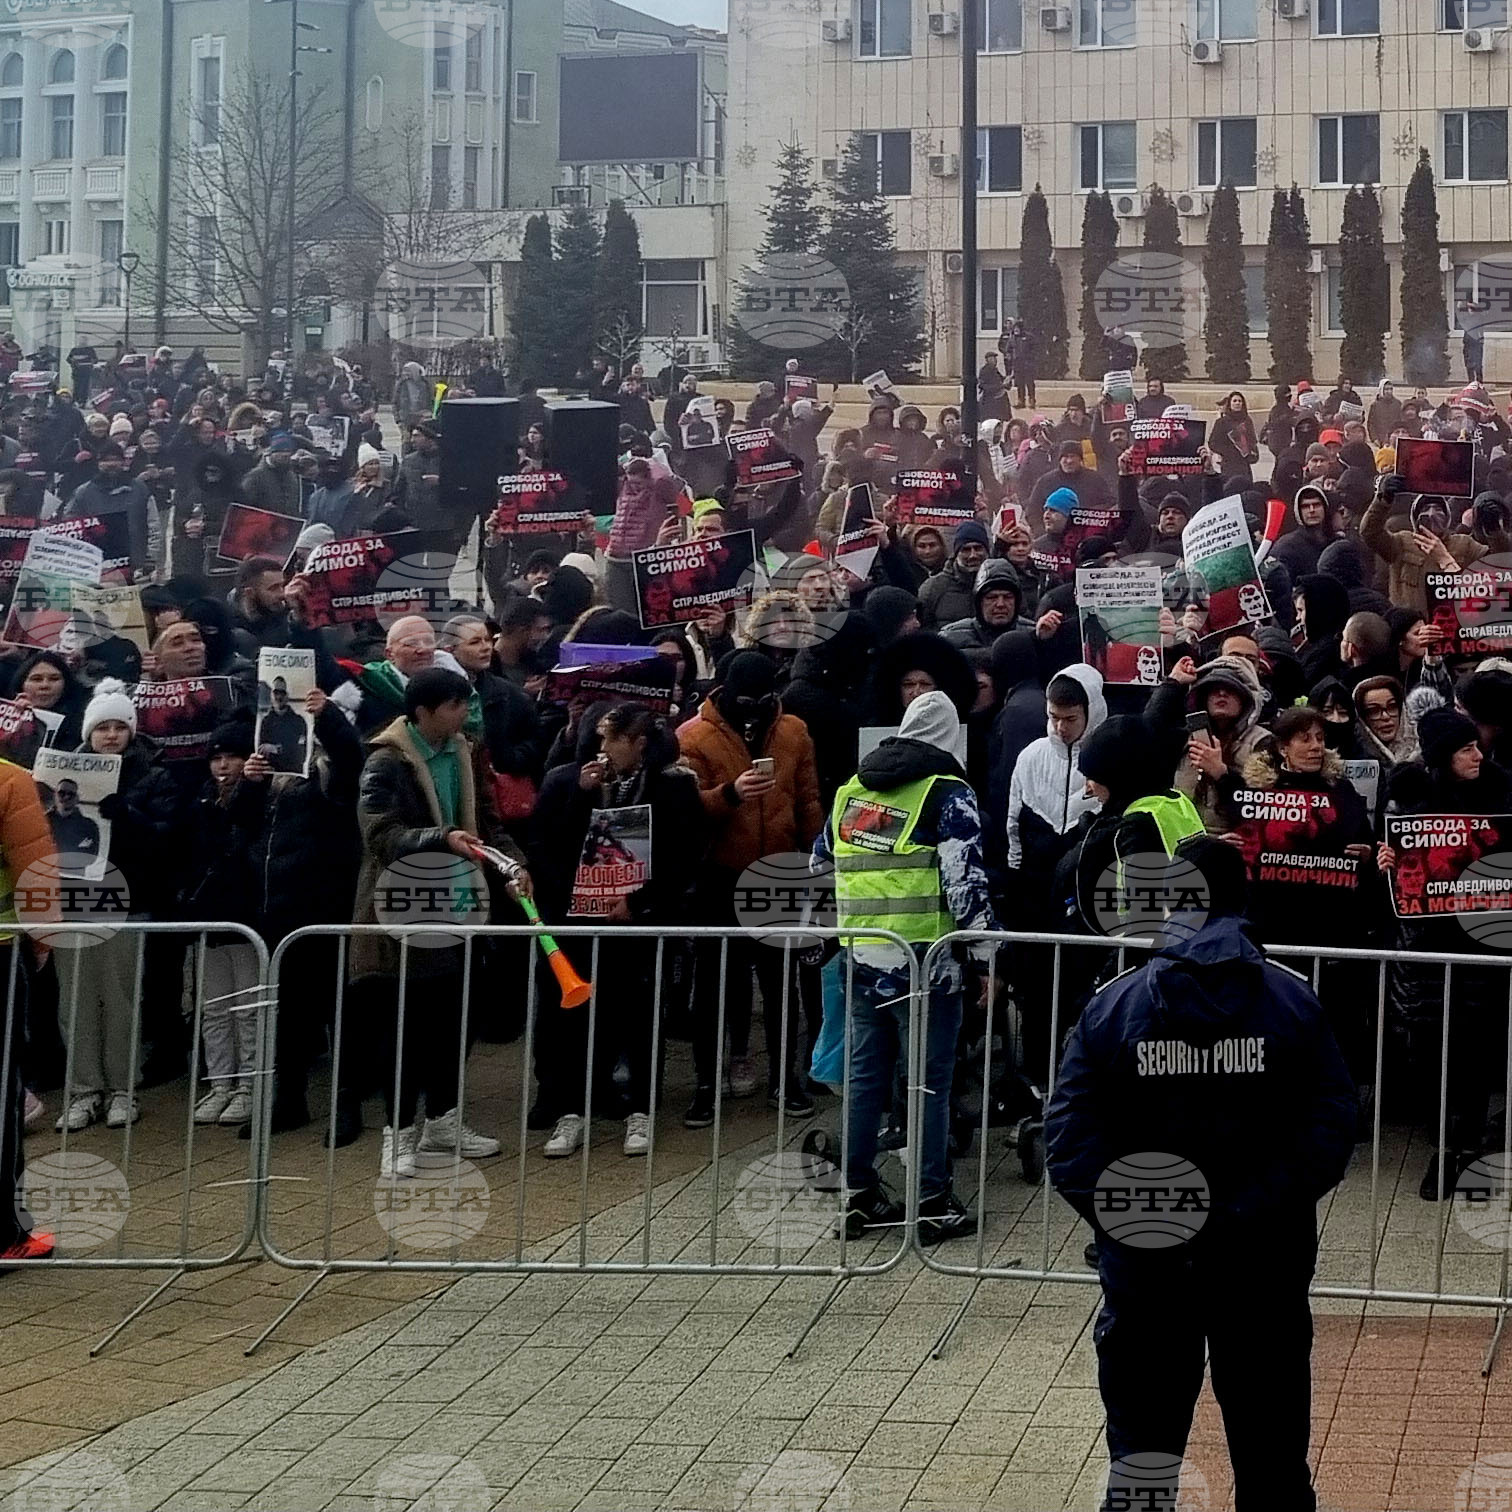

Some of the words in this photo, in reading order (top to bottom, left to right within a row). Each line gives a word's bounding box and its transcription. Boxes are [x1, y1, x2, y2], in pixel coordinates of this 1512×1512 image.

[1130, 423, 1170, 432] СВОБОДА
[1134, 431, 1171, 440] СИМО!
[501, 483, 547, 494] СИМО!
[902, 478, 944, 489] СИМО!
[365, 539, 385, 550] ЗА
[638, 545, 703, 564] СВОБОДА
[705, 541, 722, 552] ЗА
[647, 556, 706, 575] СИМО!
[1427, 573, 1491, 585] СВОБОДА
[1495, 572, 1512, 583] ЗА
[332, 588, 424, 607] СПРАВЕДЛИВОСТ
[672, 582, 752, 608] СПРАВЕДЛИВОСТ
[1435, 585, 1494, 599] СИМО!
[188, 681, 206, 692] ЗА
[1233, 790, 1307, 808] СВОБОДА
[1311, 795, 1330, 808] ЗА
[1241, 805, 1307, 822] СИМО!
[1391, 819, 1466, 833] СВОБОДА
[1470, 819, 1491, 830] ЗА
[1400, 832, 1467, 848] СИМО!
[1260, 853, 1359, 871] СПРАВЕДЛИВОСТ
[1398, 899, 1422, 914] ЗА
[1213, 1037, 1265, 1073] POLICE
